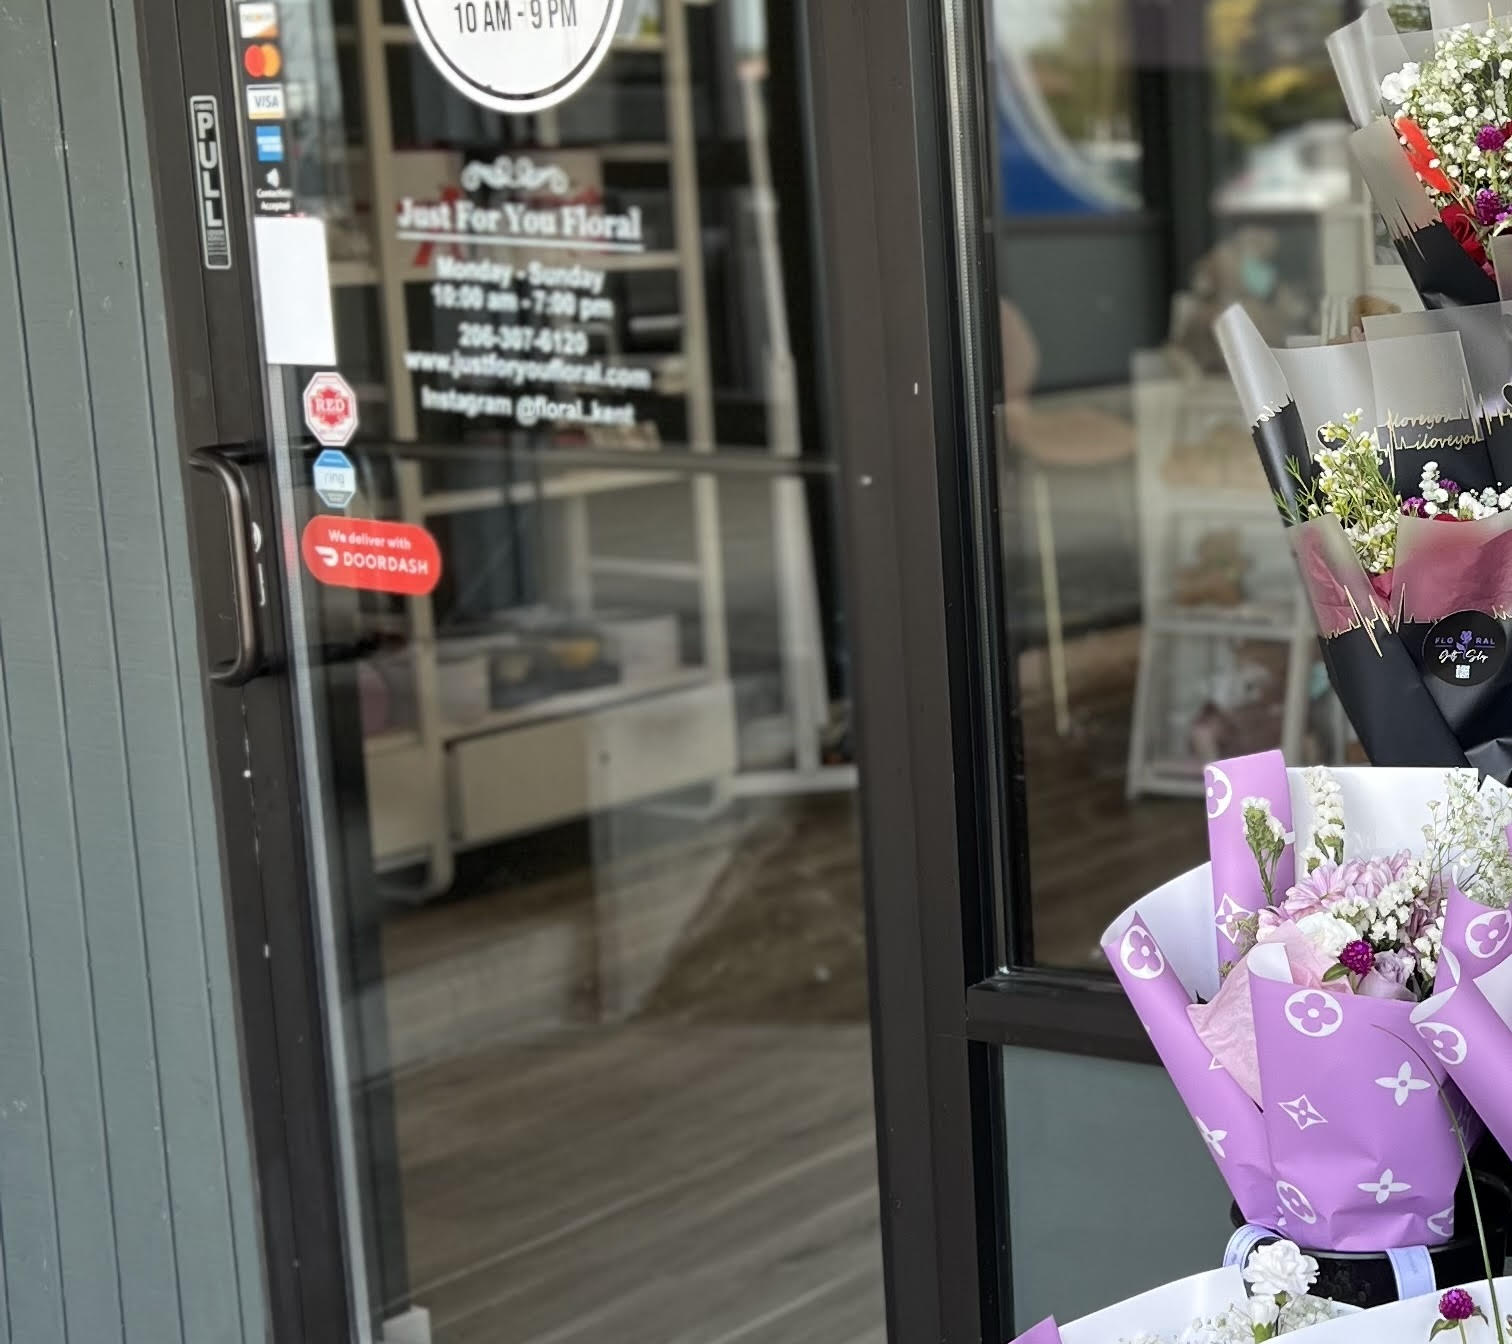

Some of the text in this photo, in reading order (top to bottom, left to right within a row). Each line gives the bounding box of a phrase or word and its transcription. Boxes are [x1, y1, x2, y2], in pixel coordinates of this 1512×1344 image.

[454, 2, 476, 33] 10
[484, 0, 511, 32] AM
[254, 95, 279, 108] VISA
[197, 111, 222, 227] PULL
[397, 198, 642, 238] Just For You Floral
[436, 256, 513, 288] Monday
[528, 261, 605, 294] Sunday
[580, 297, 614, 322] pm
[315, 398, 346, 414] RED
[324, 470, 345, 487] ring
[328, 529, 411, 550] We deliver with
[343, 552, 428, 574] DOORDASH
[1475, 637, 1495, 645] RAL
